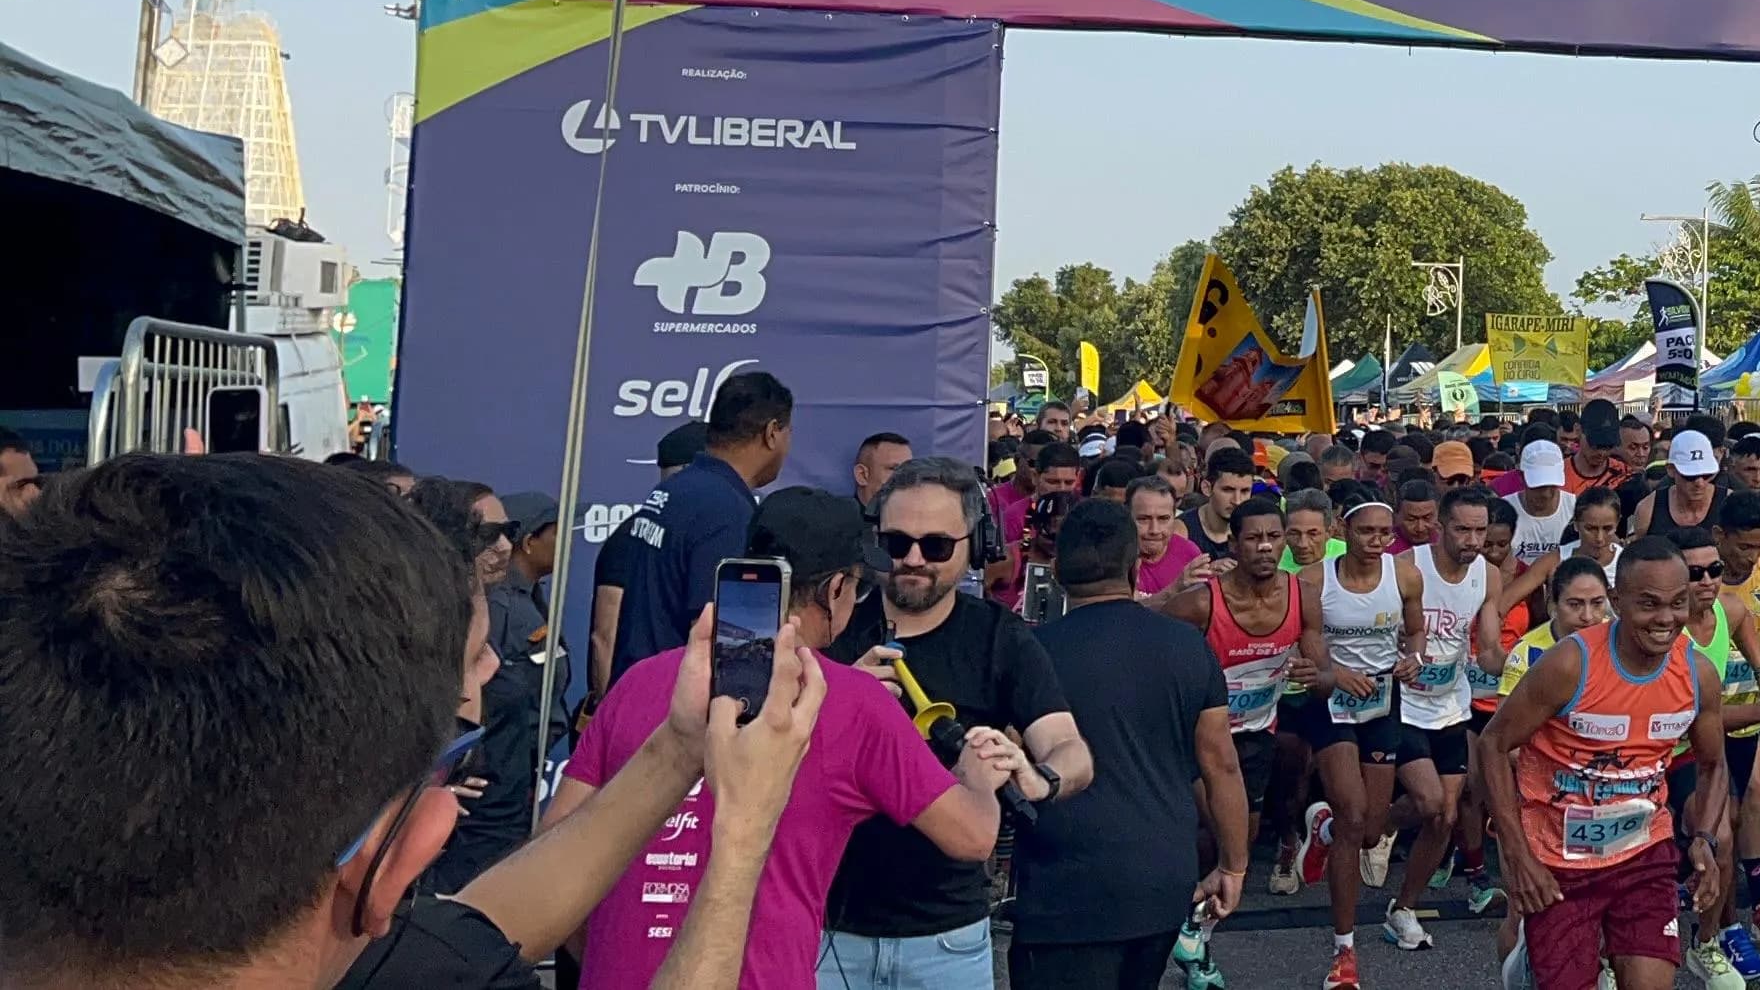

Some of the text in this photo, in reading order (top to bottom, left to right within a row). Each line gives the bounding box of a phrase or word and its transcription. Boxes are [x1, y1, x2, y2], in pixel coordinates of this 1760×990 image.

[681, 66, 747, 80] REALIZAÇÃO:
[674, 181, 741, 195] PATROCÍNIO:
[652, 321, 758, 335] SUPERMERCADOS
